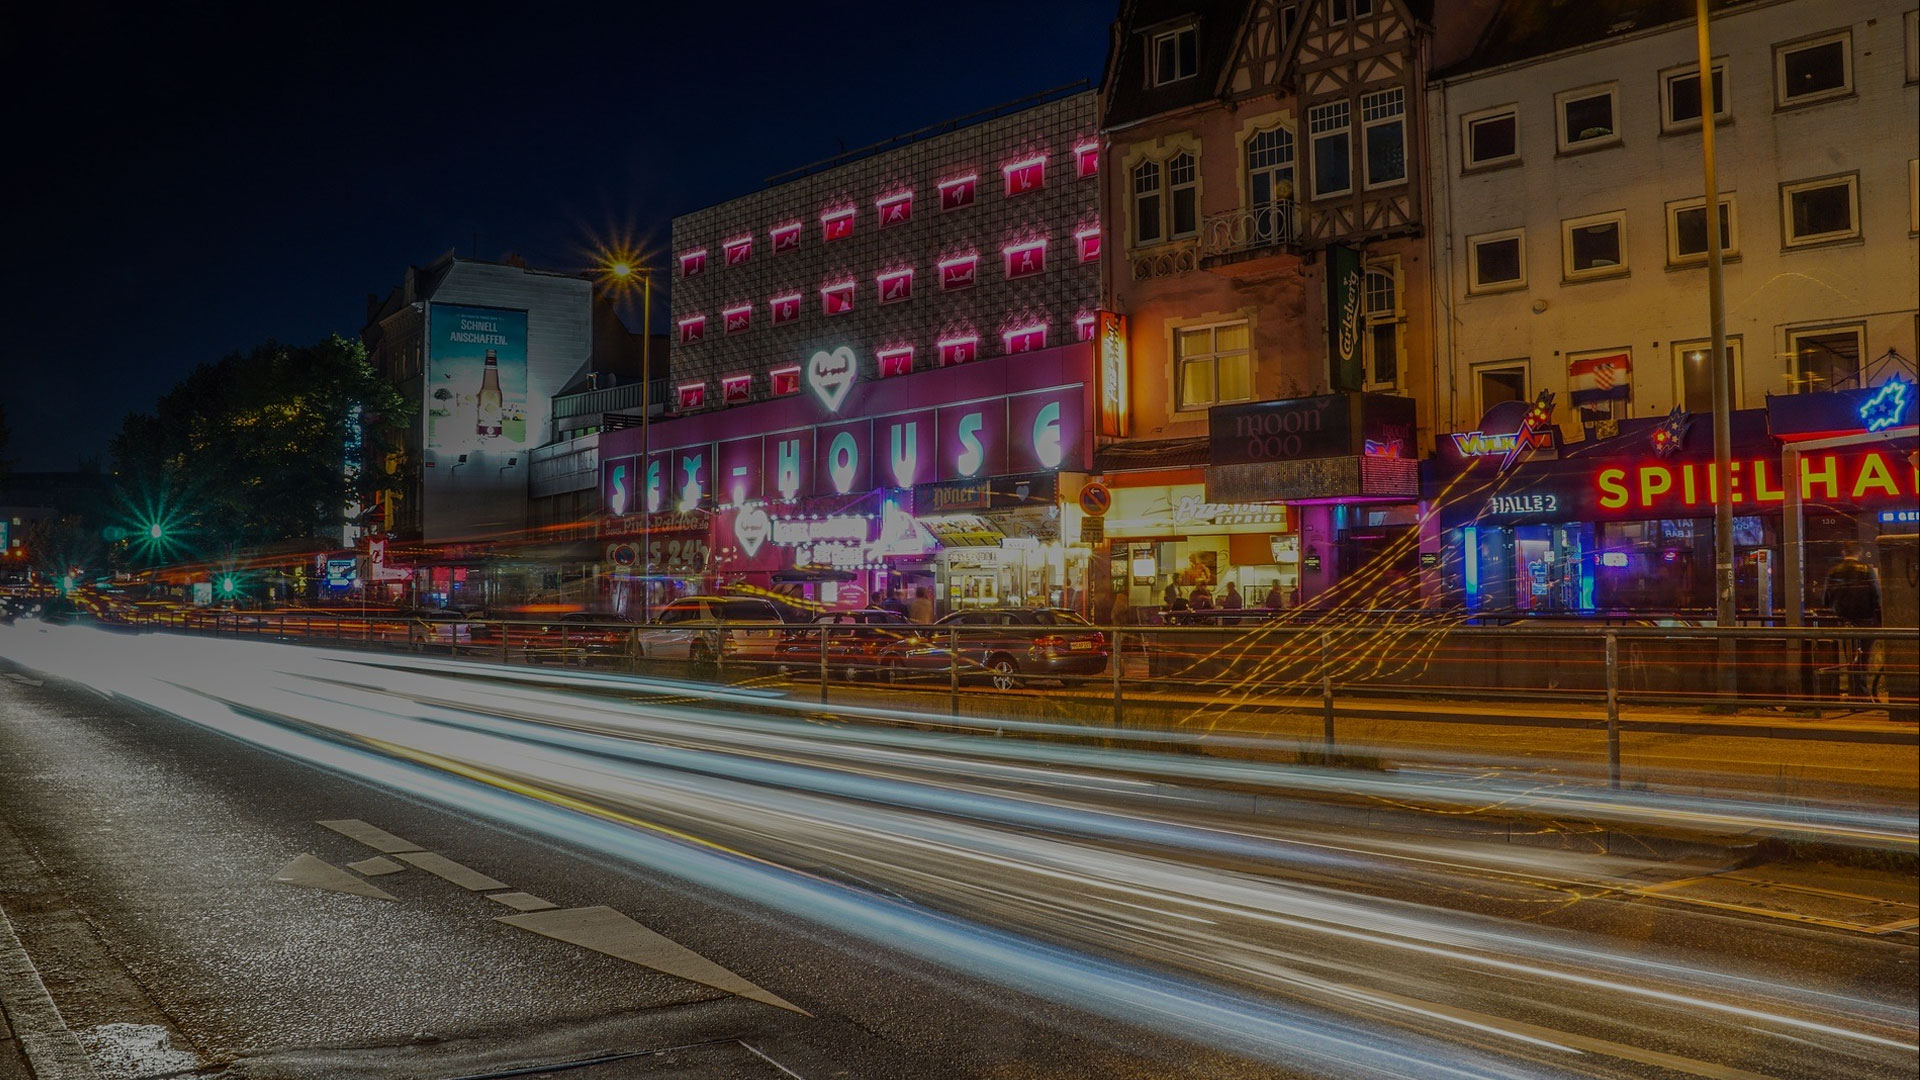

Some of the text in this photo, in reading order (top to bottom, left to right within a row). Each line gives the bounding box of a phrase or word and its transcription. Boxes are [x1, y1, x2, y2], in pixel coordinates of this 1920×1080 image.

[1339, 271, 1359, 361] Carlsberg
[460, 319, 499, 333] SCHNELL
[450, 331, 509, 347] ANSCHAFFEN.
[1236, 408, 1322, 438] moon
[1598, 452, 1919, 509] SPIELHA
[1175, 495, 1231, 522] Pizza
[1491, 495, 1557, 514] HALLE 2
[1215, 514, 1281, 525] EXPRESS
[1898, 511, 1919, 521] GE
